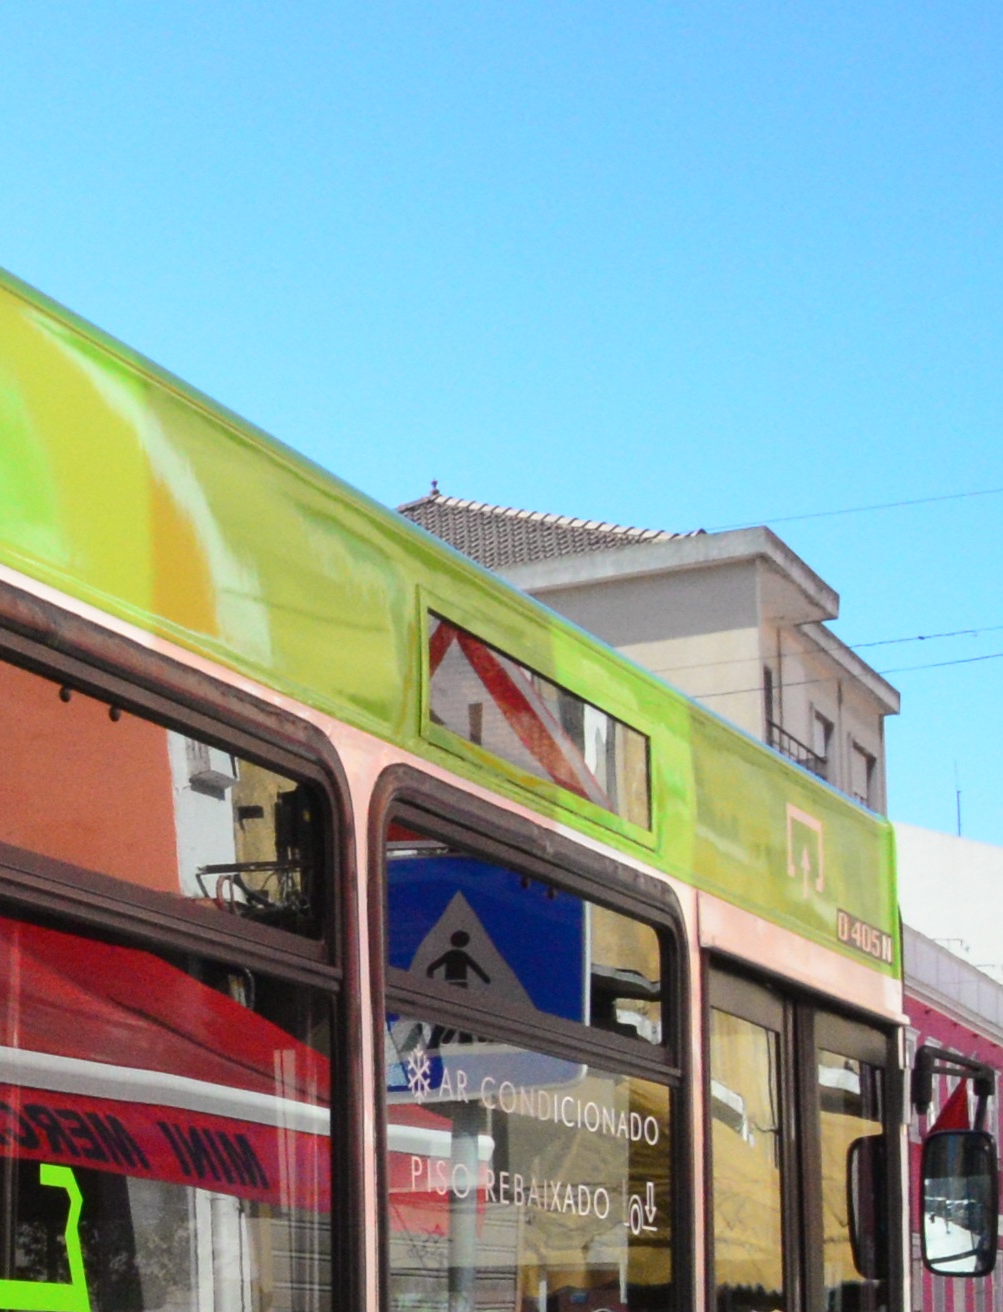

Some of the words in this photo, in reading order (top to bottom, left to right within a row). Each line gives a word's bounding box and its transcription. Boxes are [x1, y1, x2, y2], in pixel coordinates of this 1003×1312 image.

[438, 1068, 469, 1103] AR
[480, 1077, 659, 1145] CONDICIONADO
[410, 1155, 473, 1199] PISO
[484, 1168, 610, 1220] REBAIXADO
